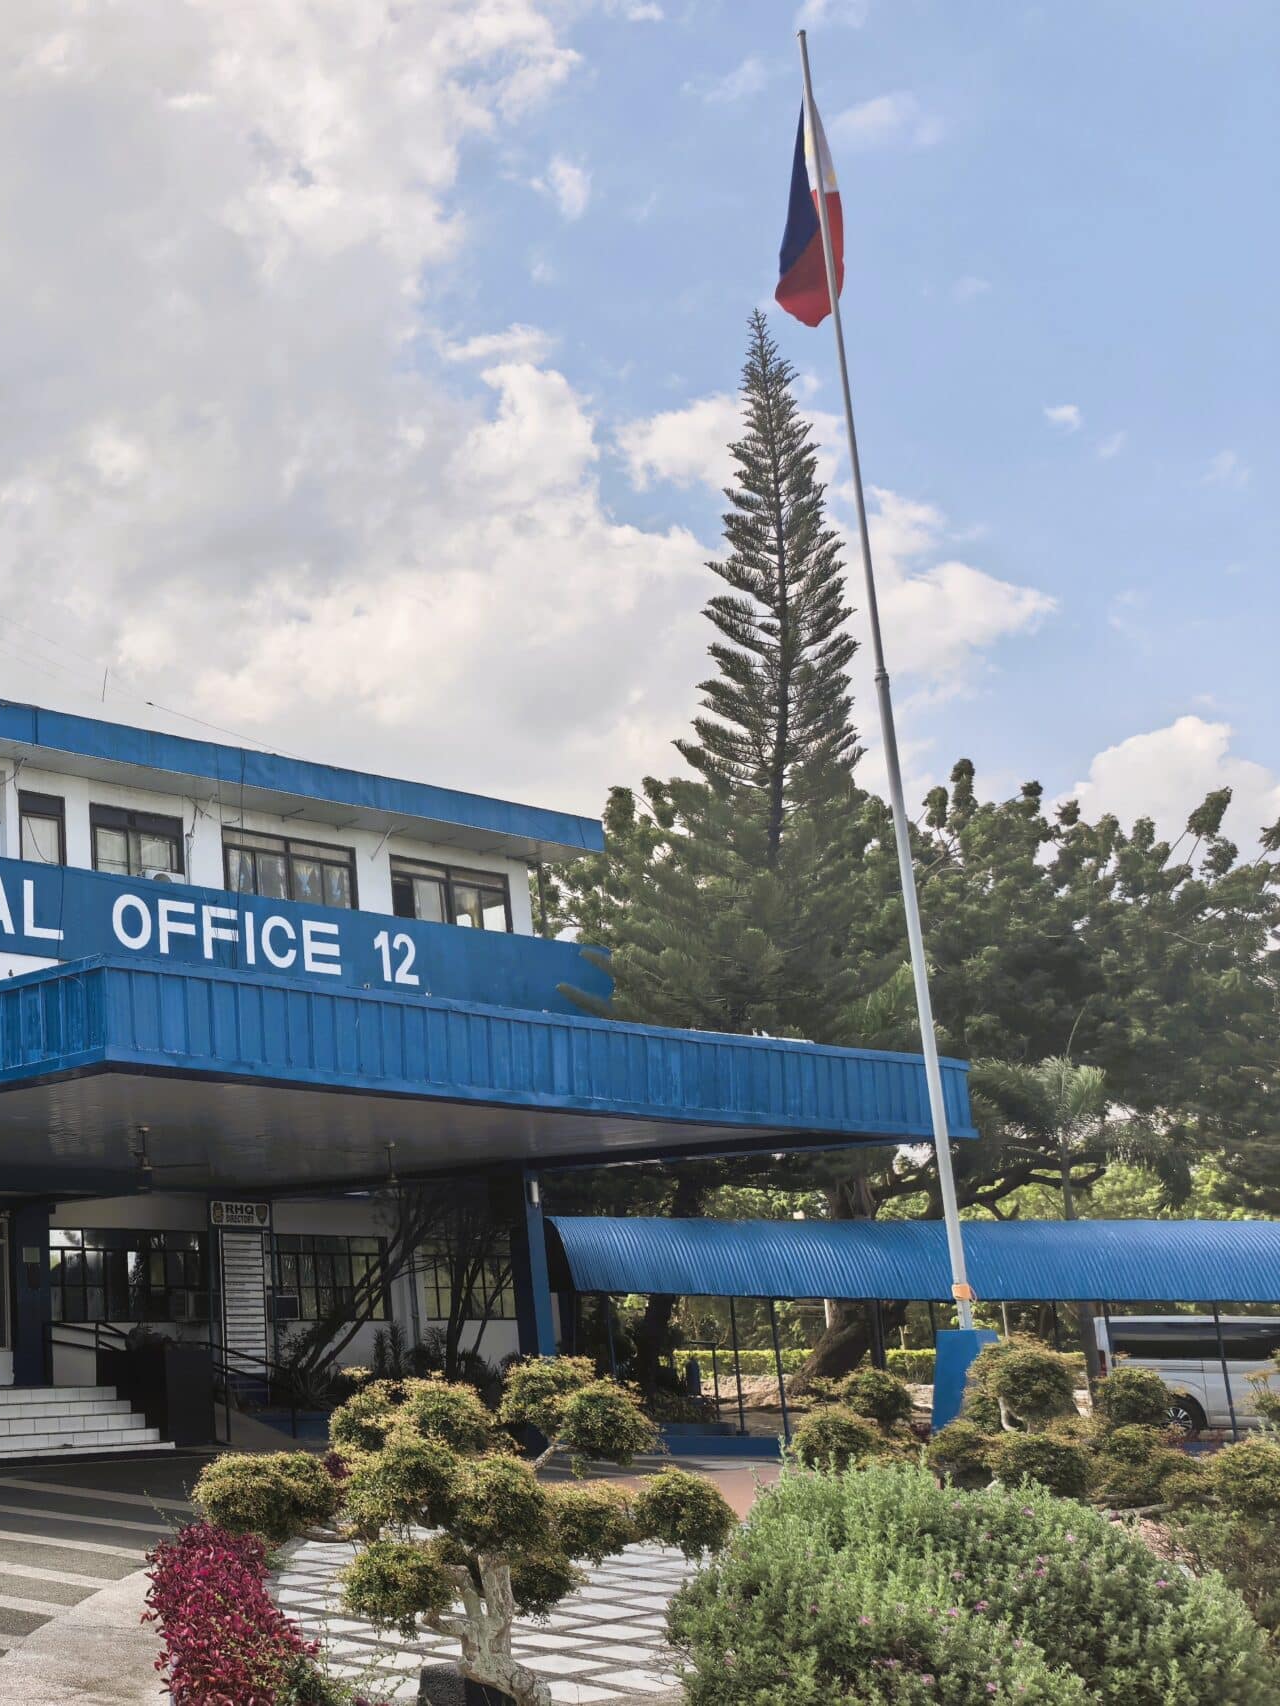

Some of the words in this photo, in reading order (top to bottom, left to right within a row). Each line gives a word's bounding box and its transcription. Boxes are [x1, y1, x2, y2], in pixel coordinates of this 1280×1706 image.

[112, 894, 342, 975] OFFICE
[374, 930, 419, 986] 12
[225, 1203, 255, 1215] RHQ
